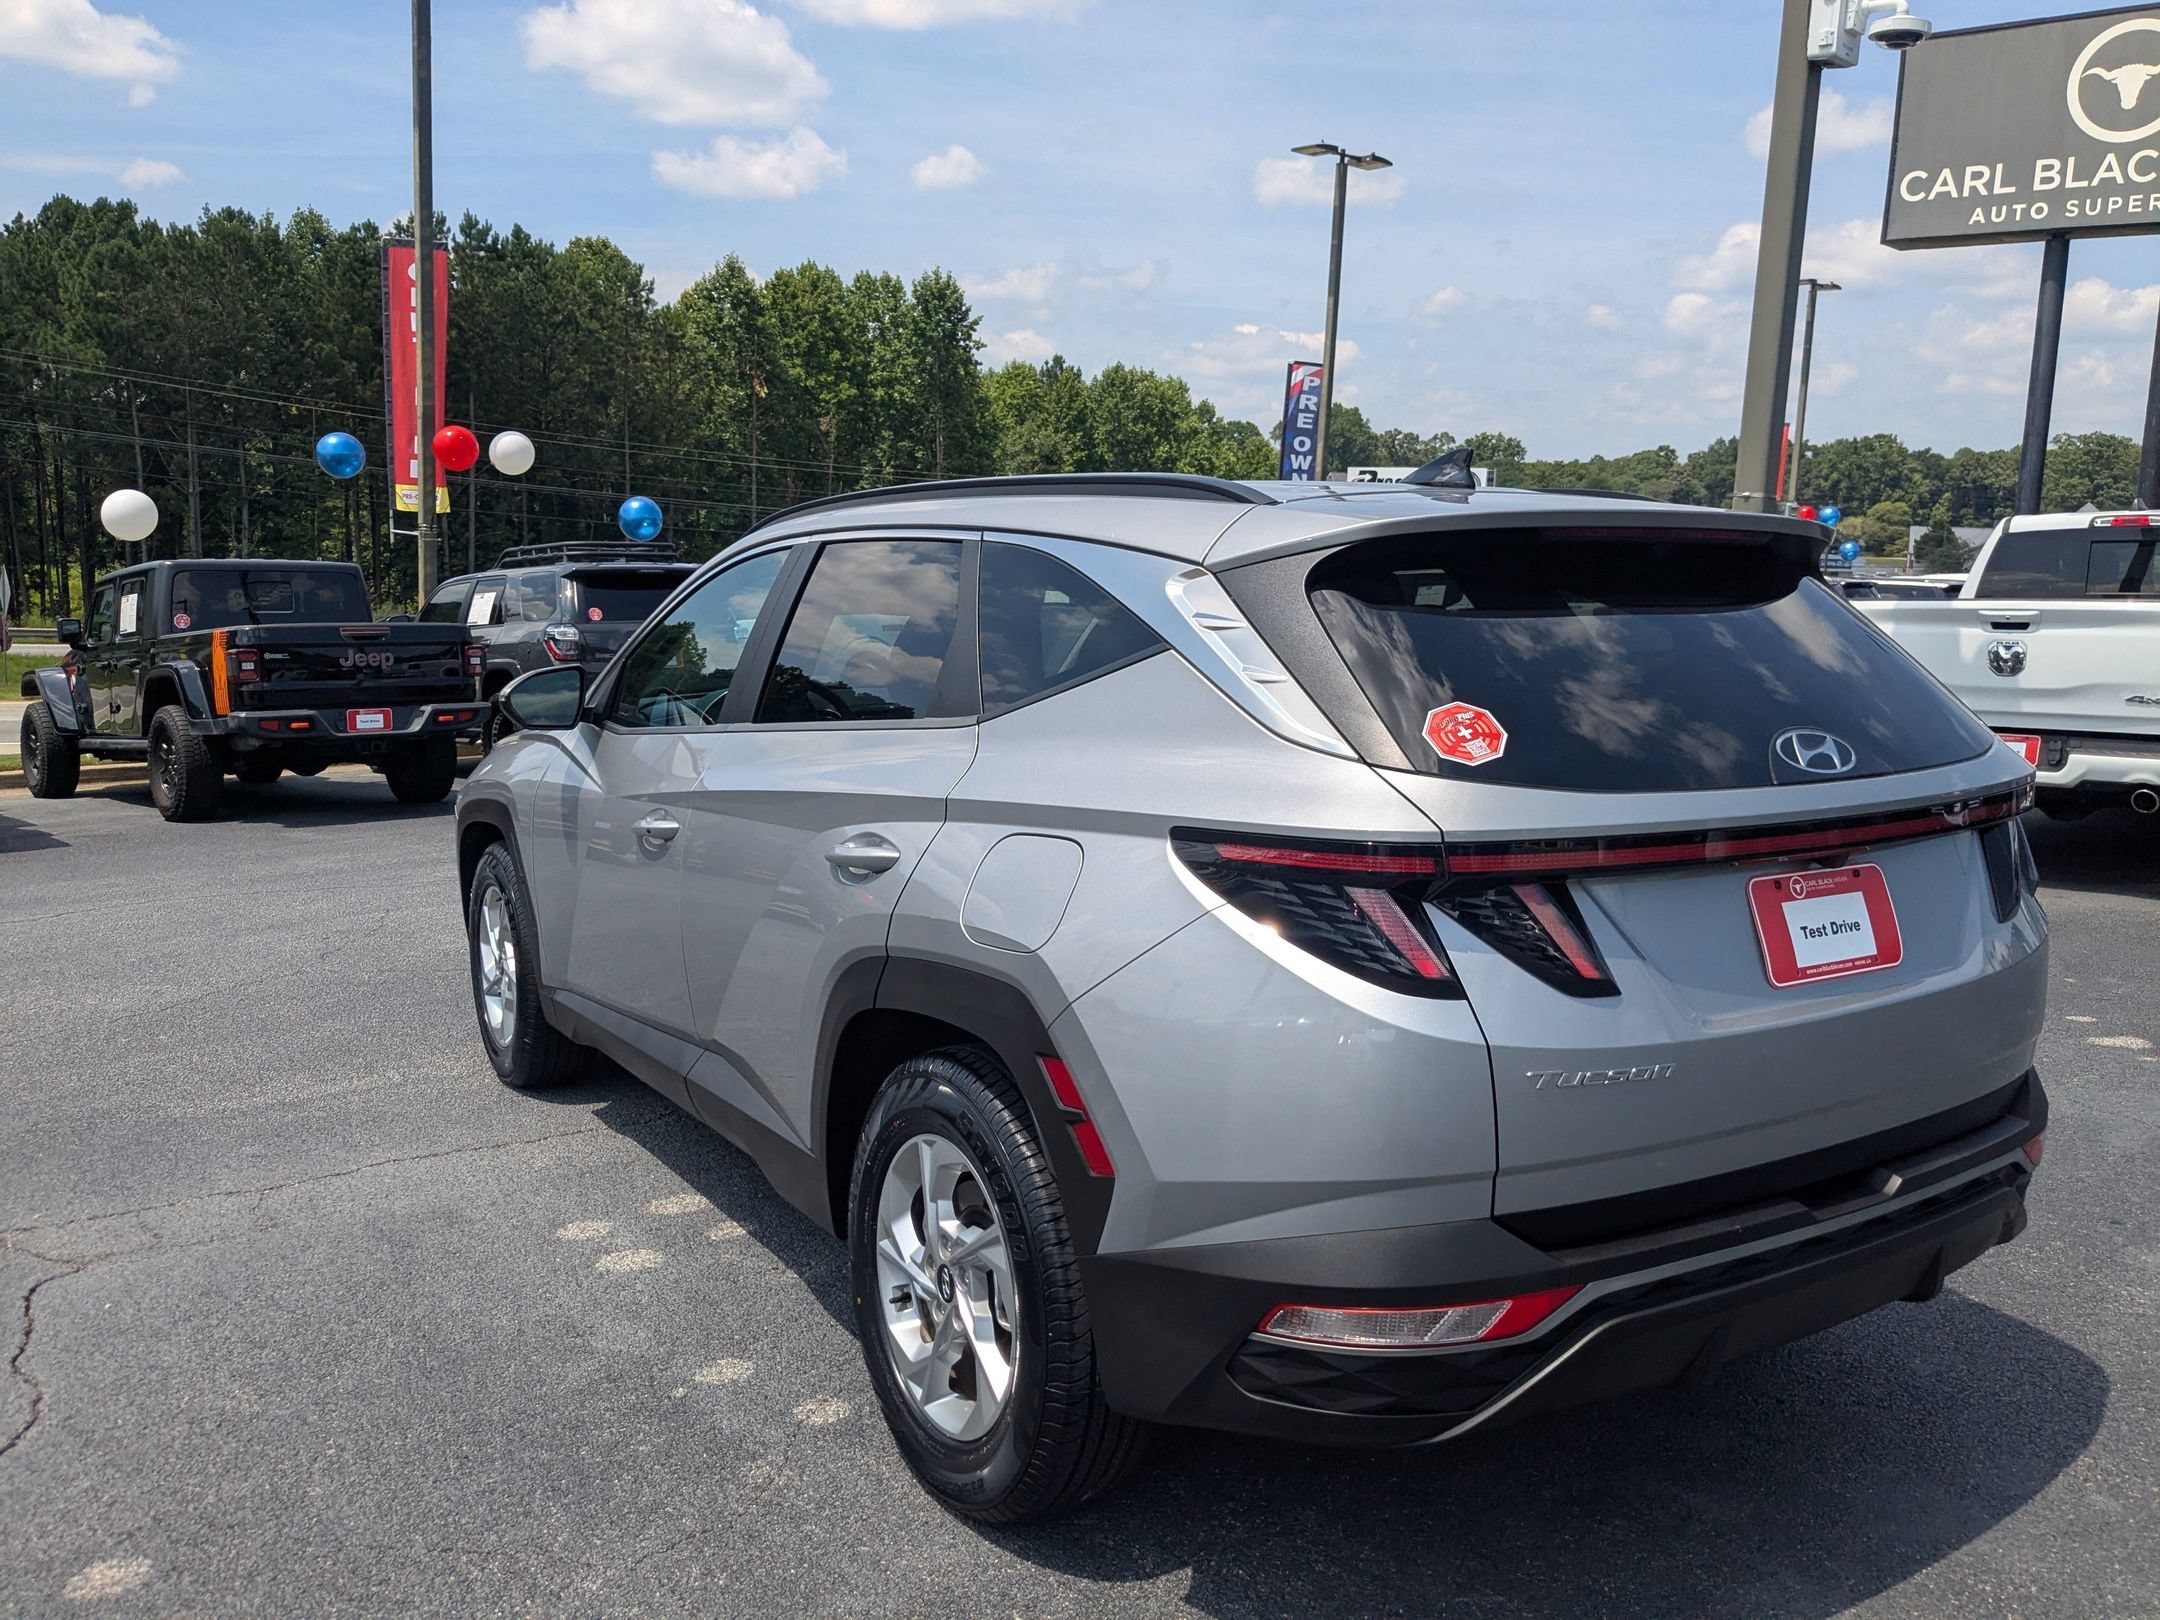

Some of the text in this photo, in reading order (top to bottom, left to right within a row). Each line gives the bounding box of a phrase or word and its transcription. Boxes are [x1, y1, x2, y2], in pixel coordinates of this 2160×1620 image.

[1899, 163, 2016, 202] CARL
[1968, 202, 2049, 225] AUTO
[1296, 376, 1321, 429] PRE
[339, 649, 394, 669] Jeep
[1799, 919, 1861, 940] Test Drive
[1525, 1062, 1677, 1090] TUCSON
